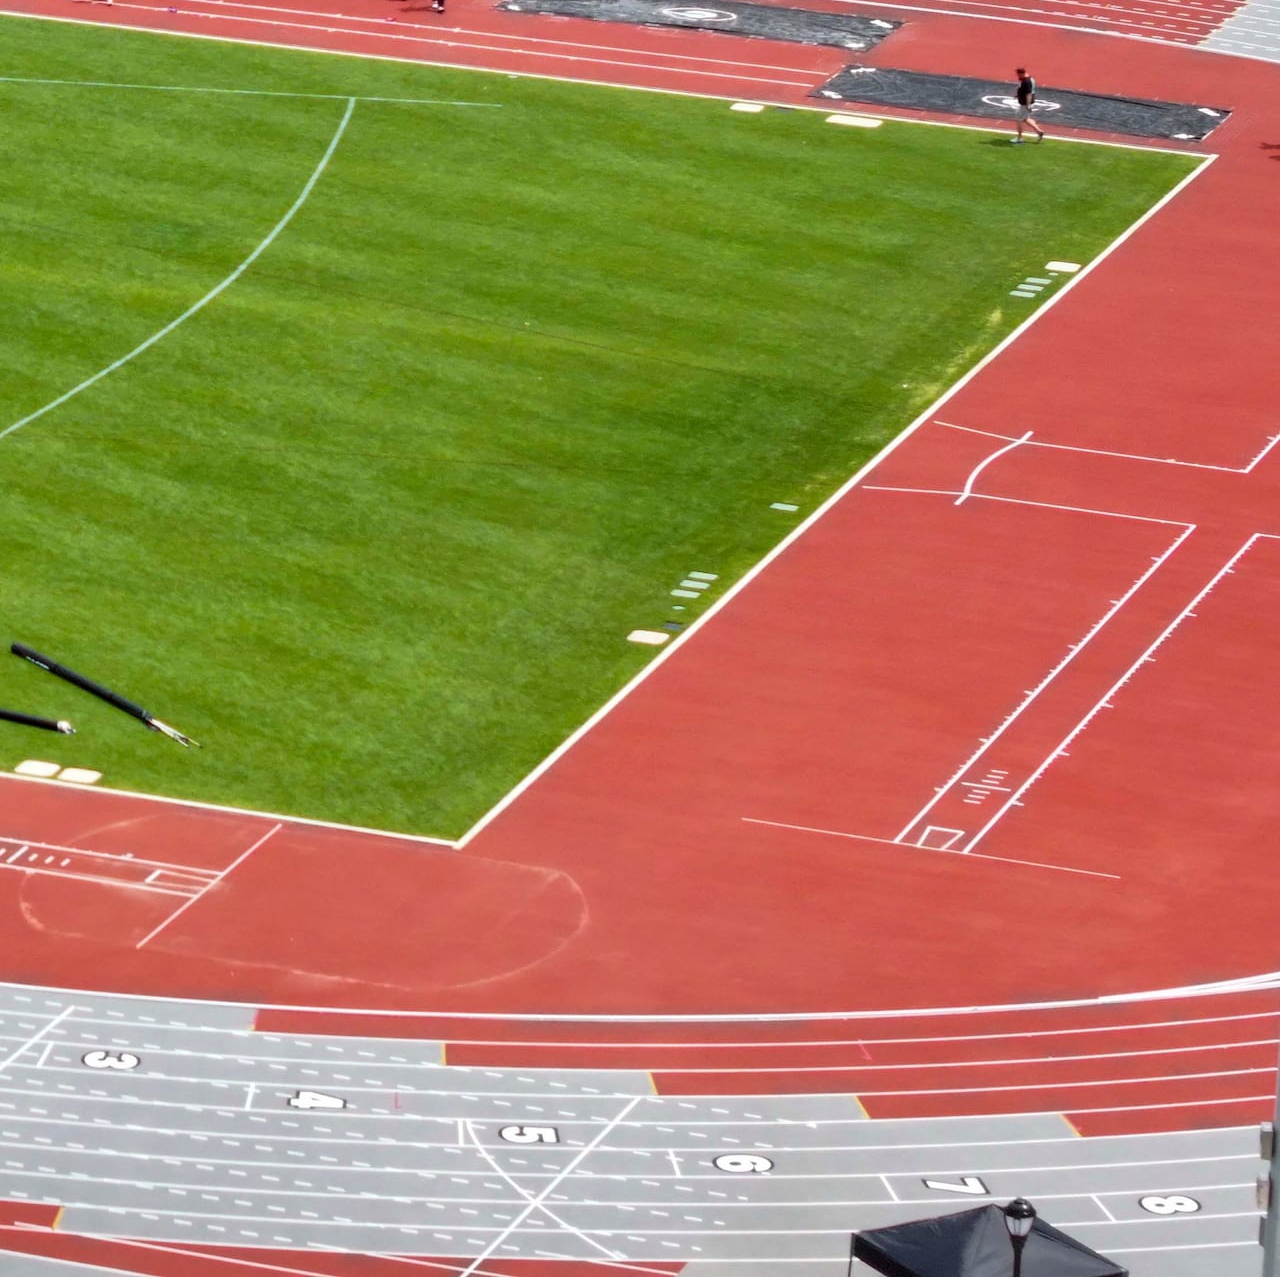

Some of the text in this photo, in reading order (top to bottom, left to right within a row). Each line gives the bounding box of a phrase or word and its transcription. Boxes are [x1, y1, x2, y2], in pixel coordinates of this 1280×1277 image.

[81, 1049, 141, 1072] 3
[287, 1090, 348, 1111] 4
[497, 1124, 562, 1146] 5
[711, 1152, 775, 1174] 6
[922, 1175, 991, 1197] 7
[1138, 1193, 1204, 1216] 8
